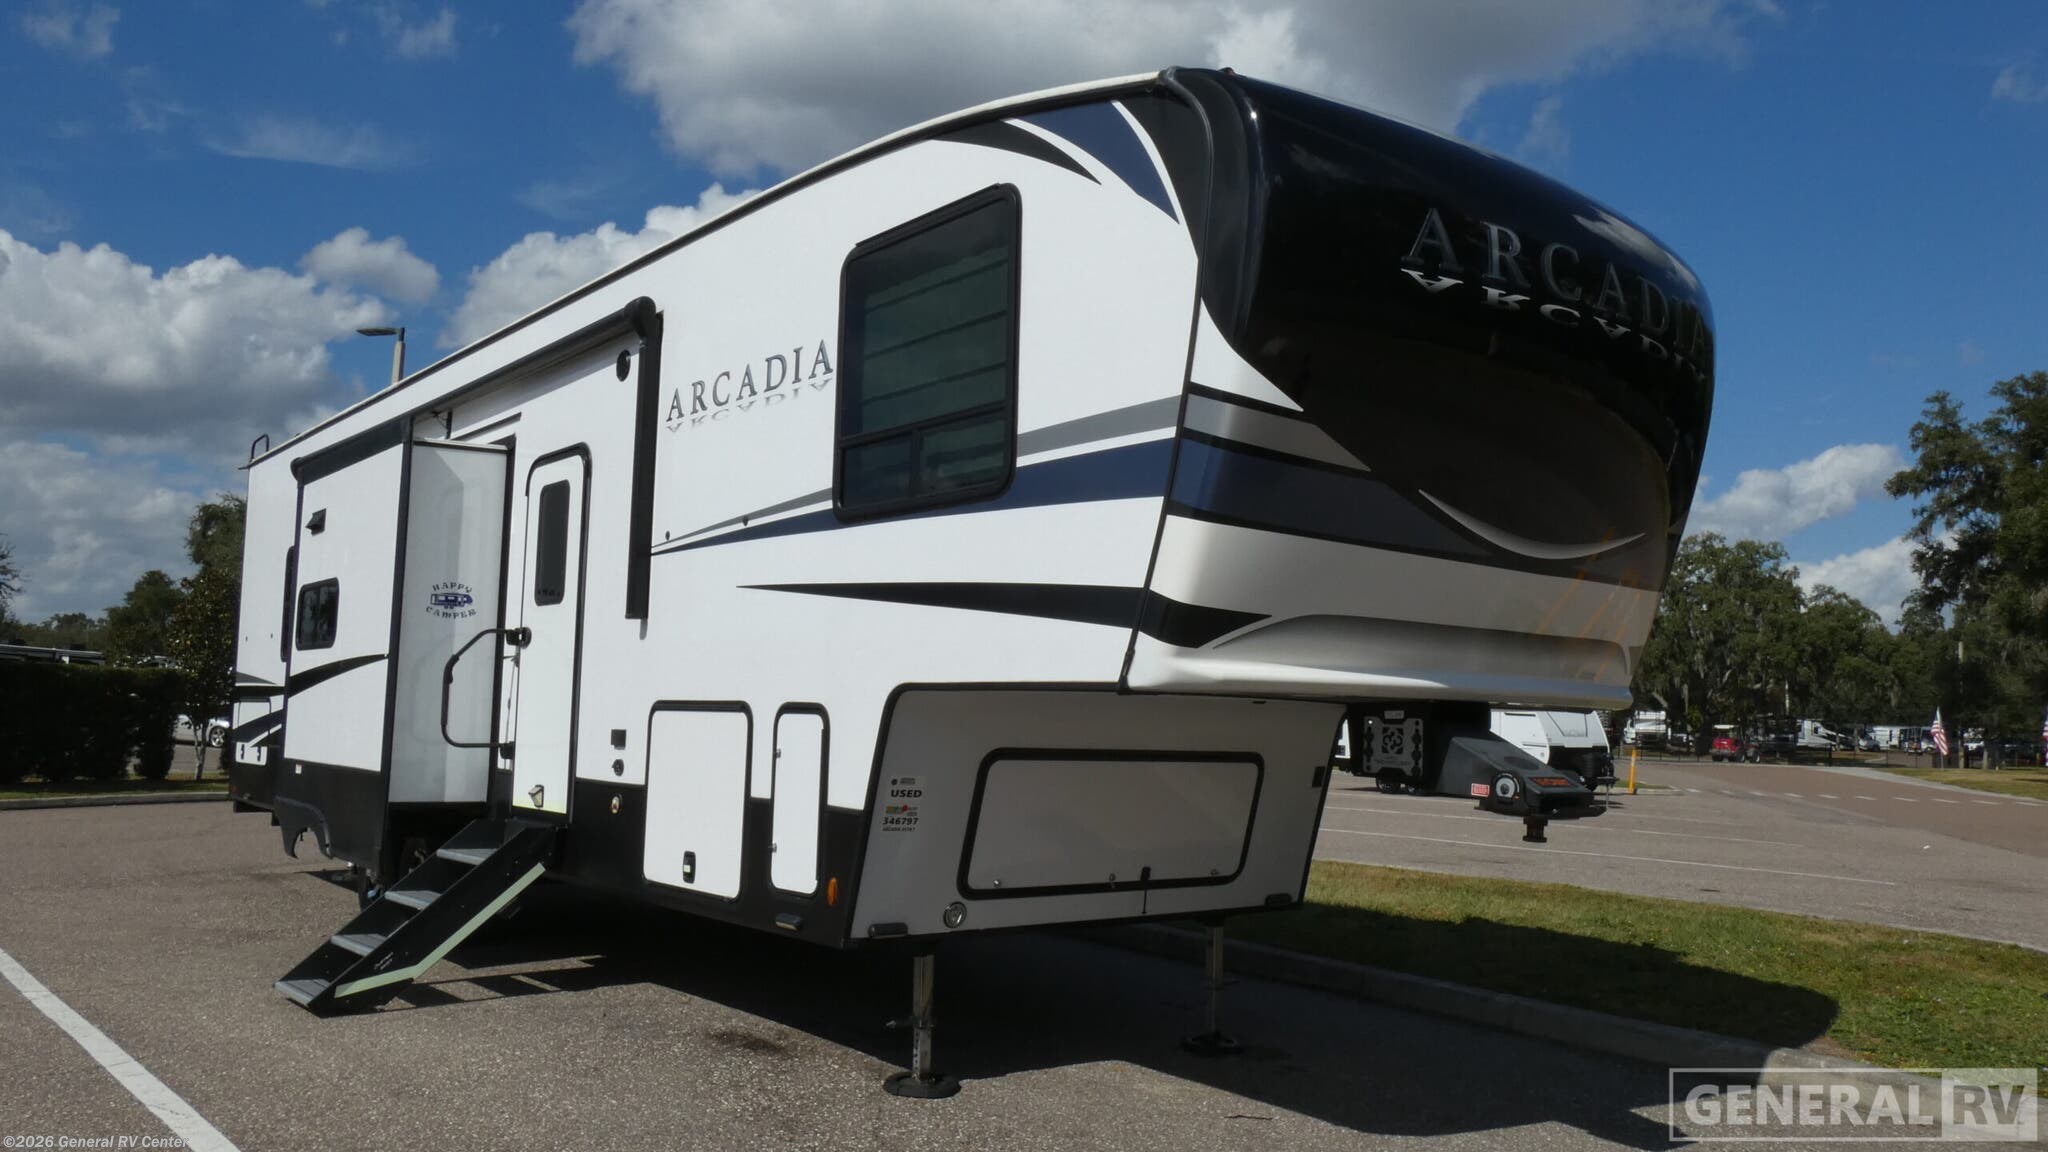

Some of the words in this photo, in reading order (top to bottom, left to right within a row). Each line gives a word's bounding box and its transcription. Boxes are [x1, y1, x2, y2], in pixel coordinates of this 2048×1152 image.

[1400, 206, 1706, 356] ARCADIA
[666, 339, 834, 422] ARCADIA
[432, 582, 473, 593] HAPPY
[426, 606, 477, 619] CAMPER
[891, 789, 922, 798] USED
[882, 817, 919, 826] 346797
